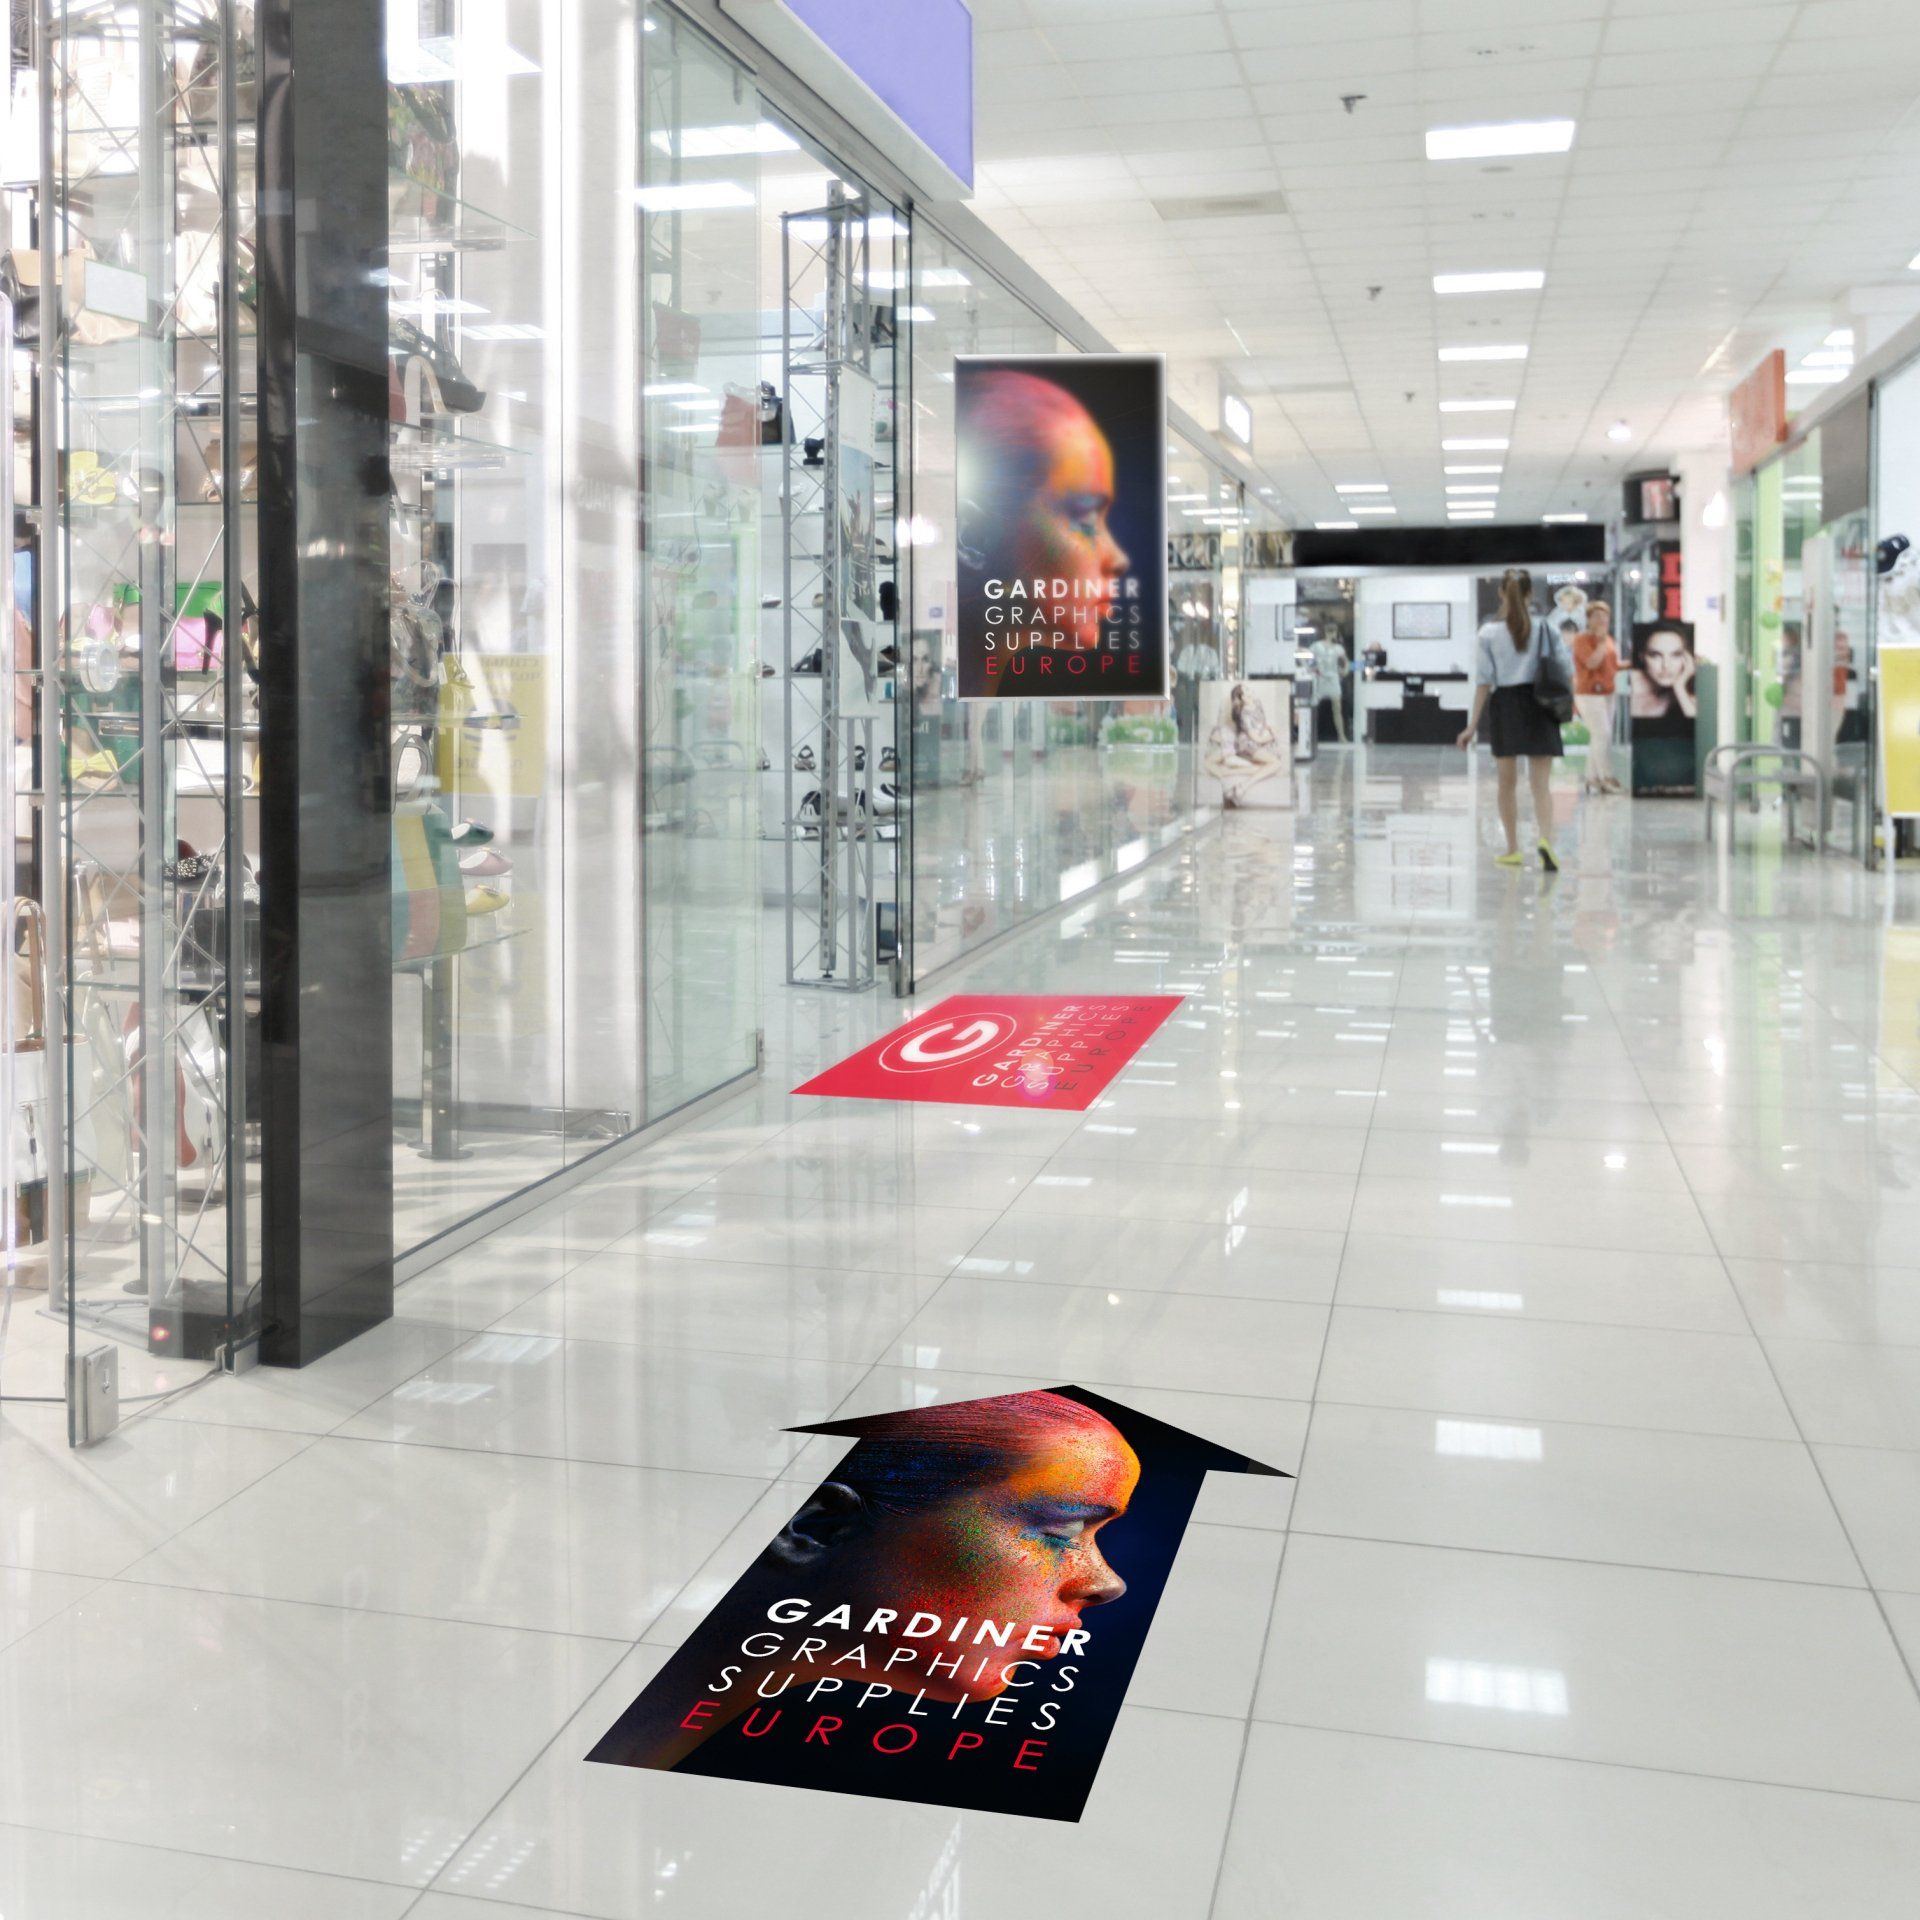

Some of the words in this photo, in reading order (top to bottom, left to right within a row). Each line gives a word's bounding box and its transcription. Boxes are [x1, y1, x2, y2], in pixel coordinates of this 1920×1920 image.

[984, 579, 1140, 600] GARDINER
[985, 606, 1141, 625] GRAPHICS
[984, 631, 1140, 650] SUPPLIES
[986, 655, 1141, 675] EUROPE
[972, 1004, 1084, 1087] GARDINER
[1000, 1004, 1107, 1089] GRAPHICS
[1026, 1005, 1130, 1090] SUPPLIES
[1054, 1005, 1152, 1091] EUROPE
[766, 1598, 1092, 1656] GARDINER
[741, 1632, 1080, 1692] GRAPHICS
[708, 1665, 1061, 1730] SUPPLIES
[680, 1700, 1049, 1771] EUROPE
